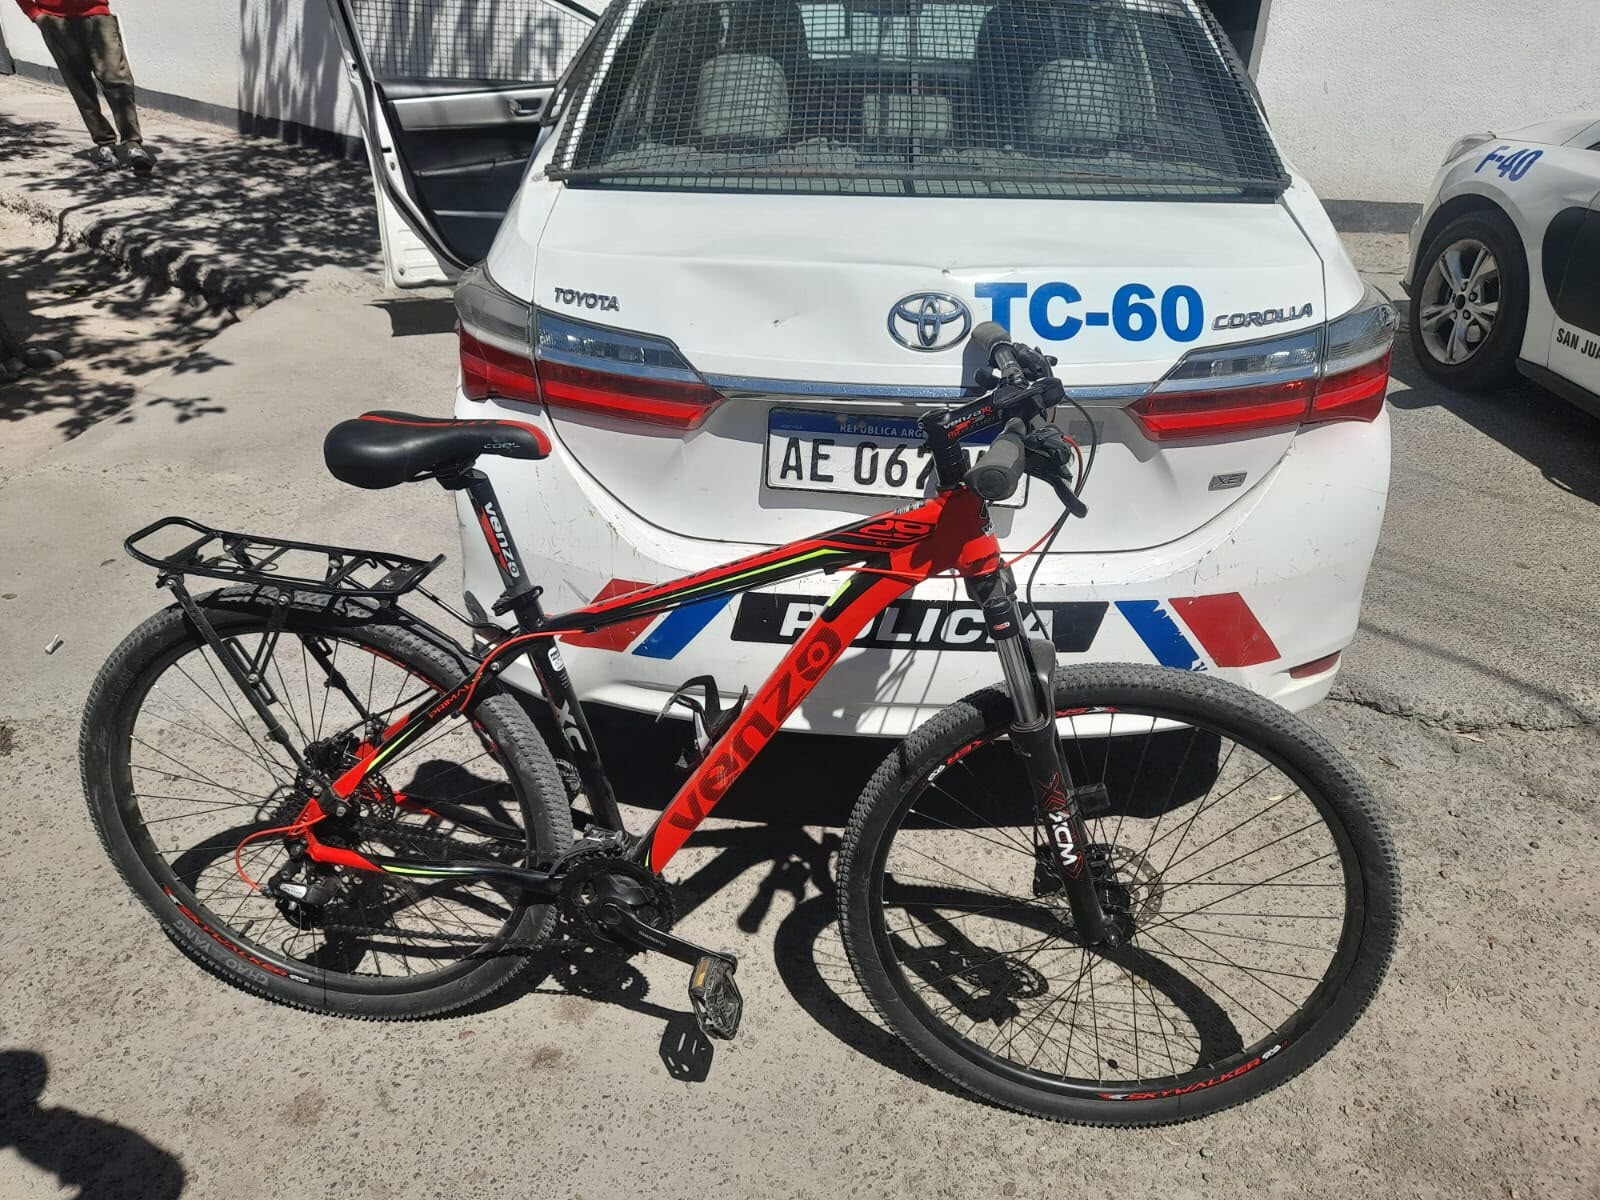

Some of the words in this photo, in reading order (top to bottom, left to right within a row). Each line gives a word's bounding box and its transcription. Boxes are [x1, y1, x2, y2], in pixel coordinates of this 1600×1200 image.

[1475, 146, 1543, 181] F-40
[555, 287, 619, 311] TOYOTA
[975, 281, 1204, 342] TC-60
[1211, 303, 1312, 330] COROLLA
[1556, 328, 1579, 350] SAN
[780, 437, 835, 483] AE
[484, 501, 520, 578] venzo
[859, 519, 930, 539] 29
[668, 627, 842, 831] venzo
